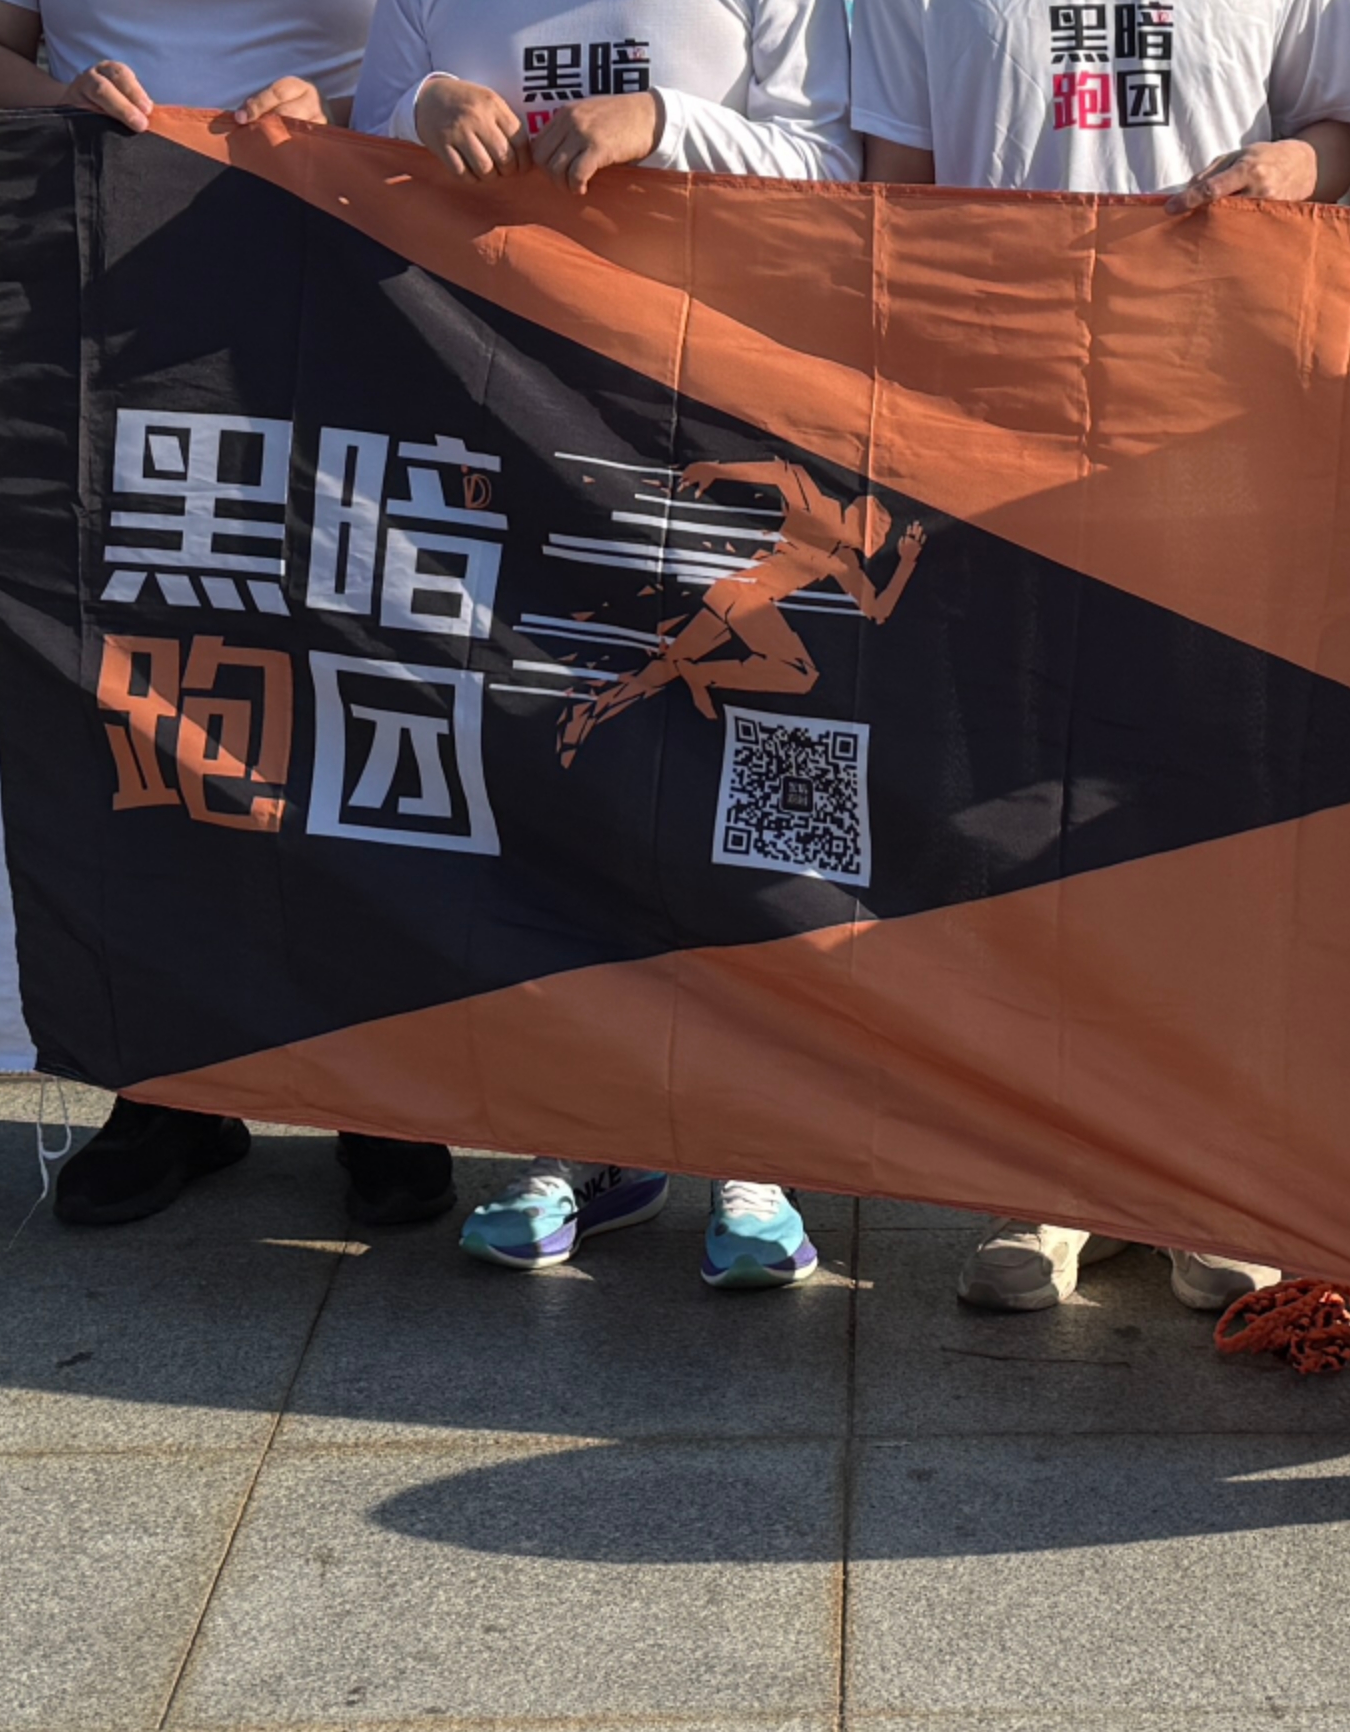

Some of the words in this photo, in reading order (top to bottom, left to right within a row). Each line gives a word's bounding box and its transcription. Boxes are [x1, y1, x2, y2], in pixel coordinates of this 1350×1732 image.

[1049, 1, 1174, 64] 黑暗
[522, 38, 650, 102] 黑暗
[1053, 70, 1172, 131] 跑团
[101, 408, 508, 639] 黑暗
[97, 635, 500, 856] 跑团
